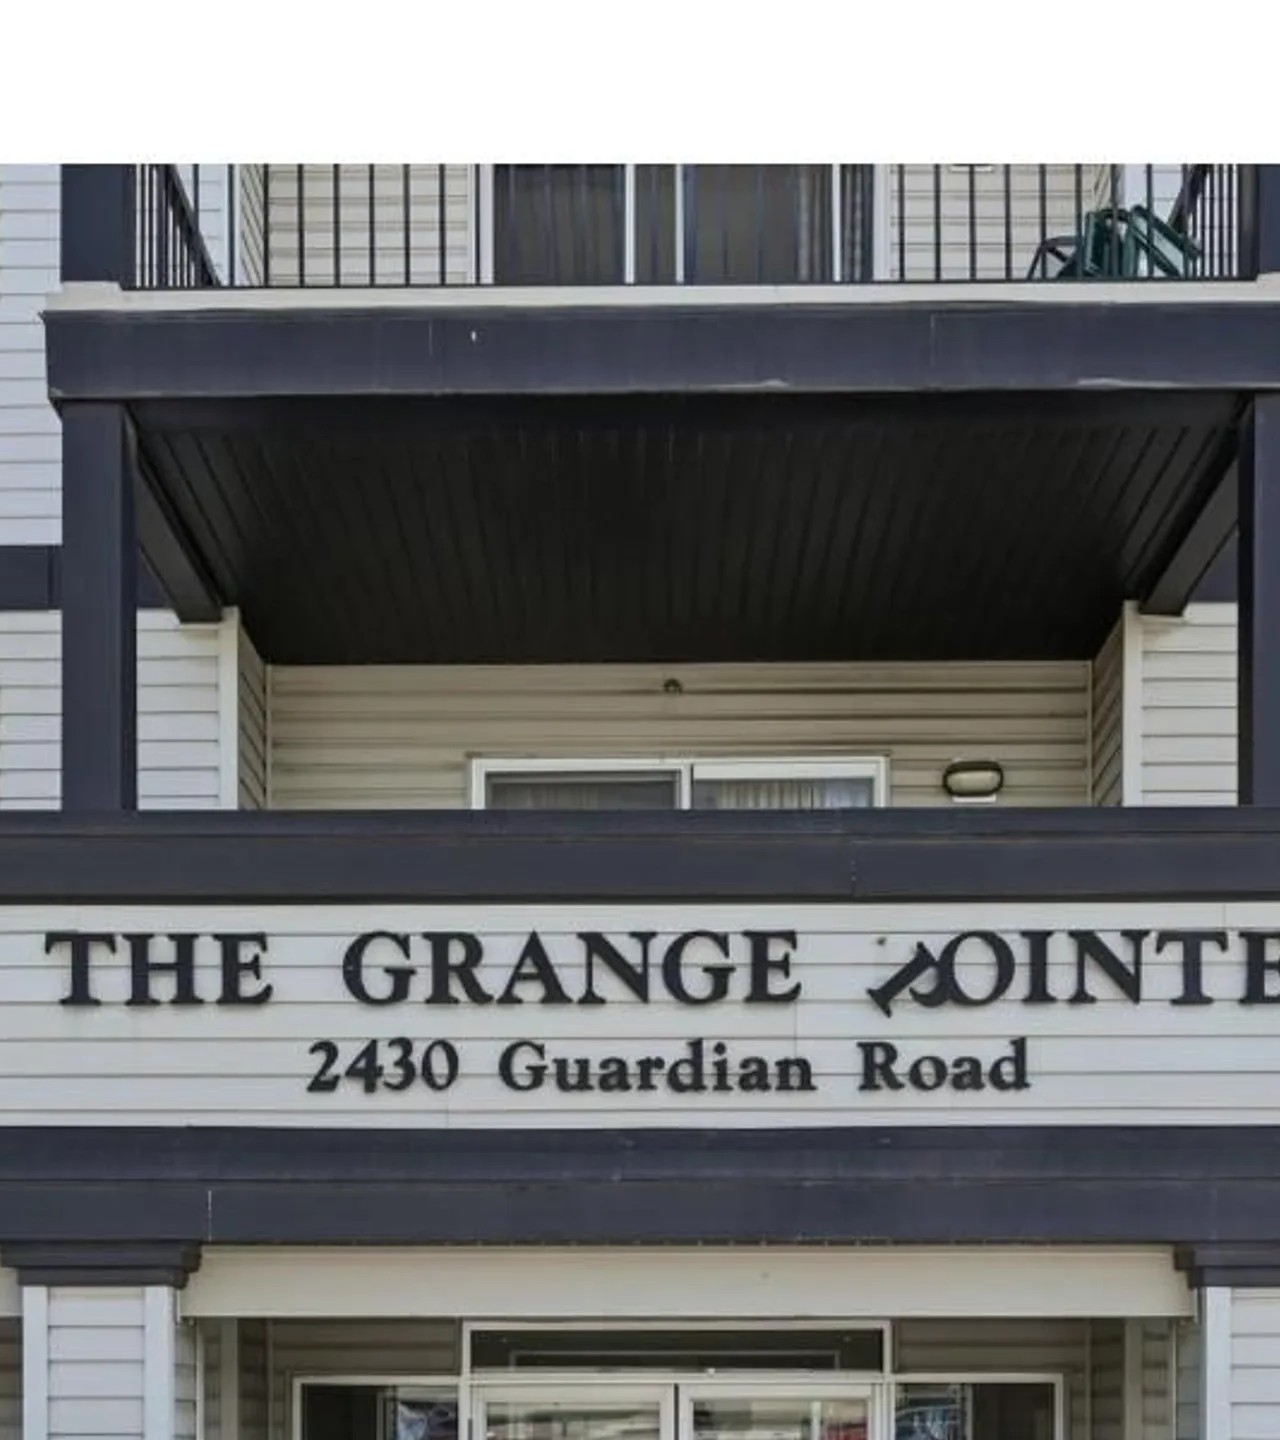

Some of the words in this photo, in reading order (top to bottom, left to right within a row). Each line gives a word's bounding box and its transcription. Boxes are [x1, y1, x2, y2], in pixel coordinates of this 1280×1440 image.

[44, 930, 273, 1007] THE
[341, 929, 802, 1007] GRANGE
[306, 1037, 459, 1094] 2430
[498, 1037, 817, 1094] Guardian
[856, 1036, 1031, 1092] Road
